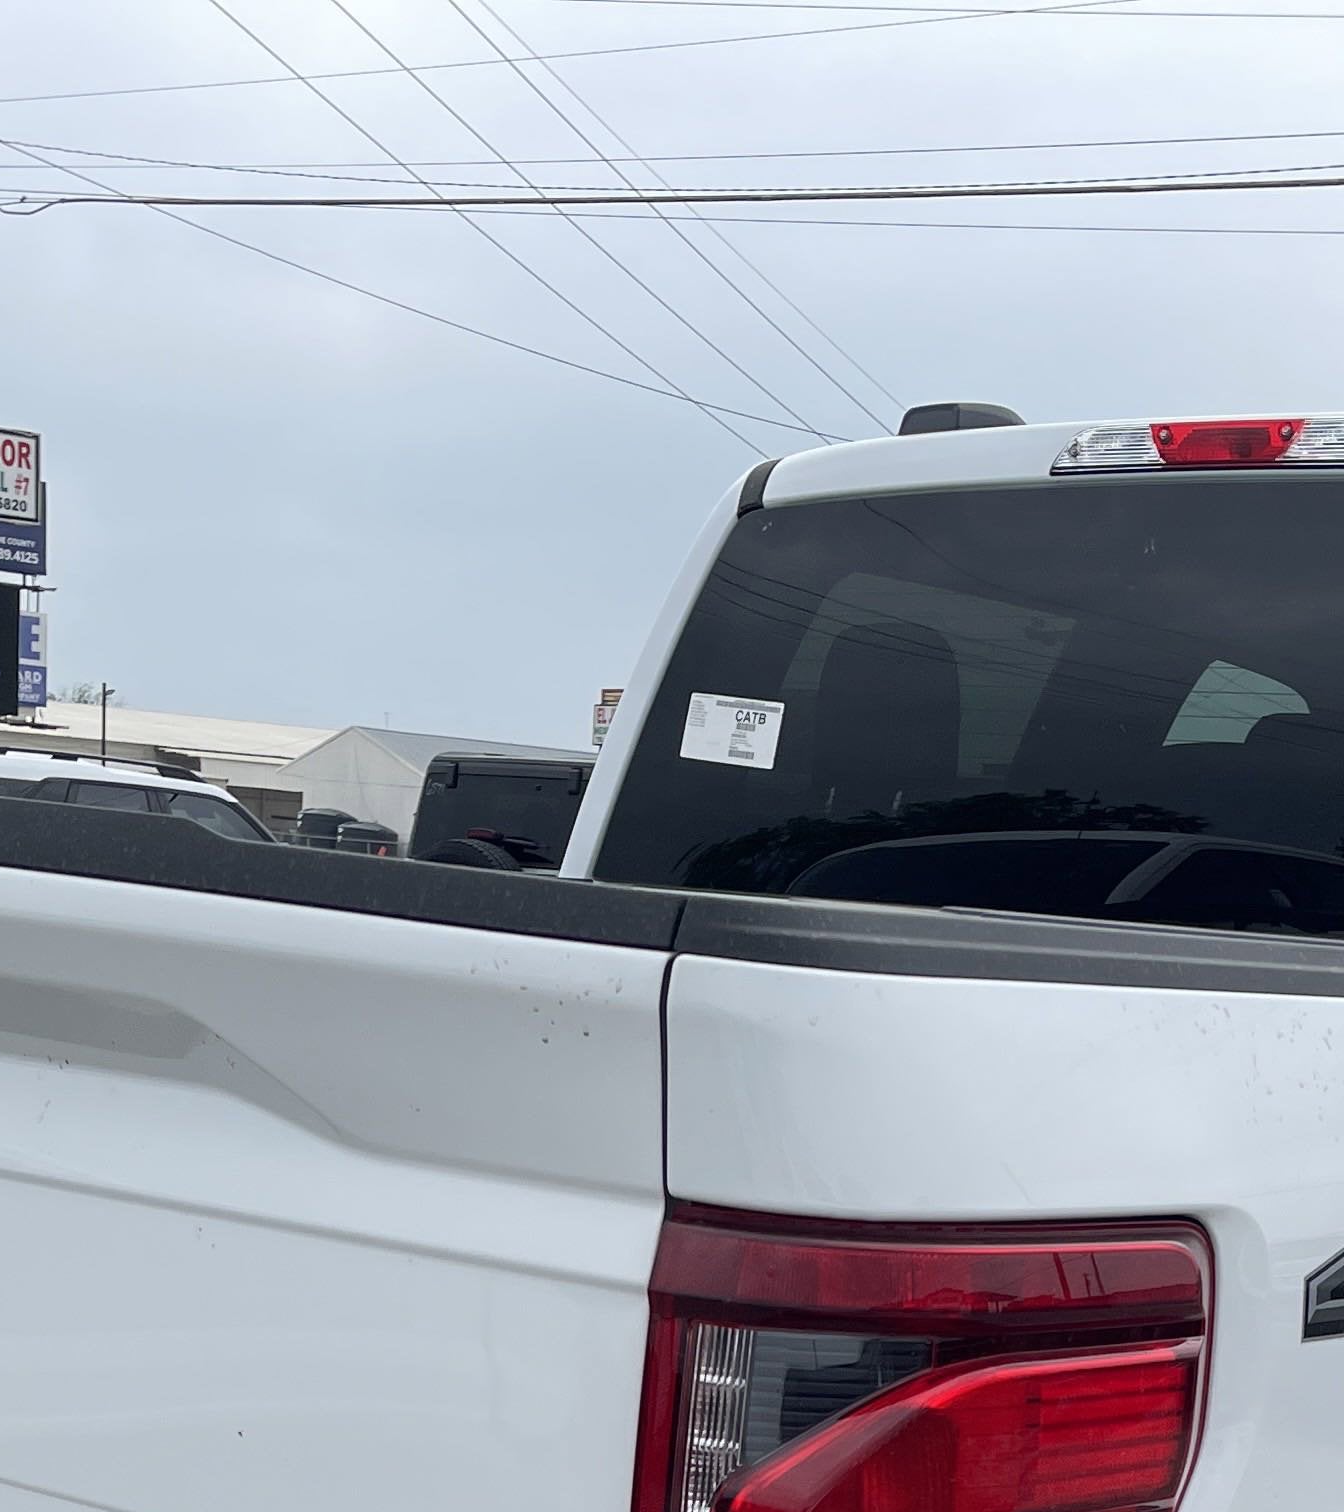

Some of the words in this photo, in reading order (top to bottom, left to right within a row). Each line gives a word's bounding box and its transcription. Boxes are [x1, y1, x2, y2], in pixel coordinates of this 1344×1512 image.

[14, 473, 30, 496] #7
[7, 537, 37, 549] COUNTY
[736, 710, 767, 725] CATB
